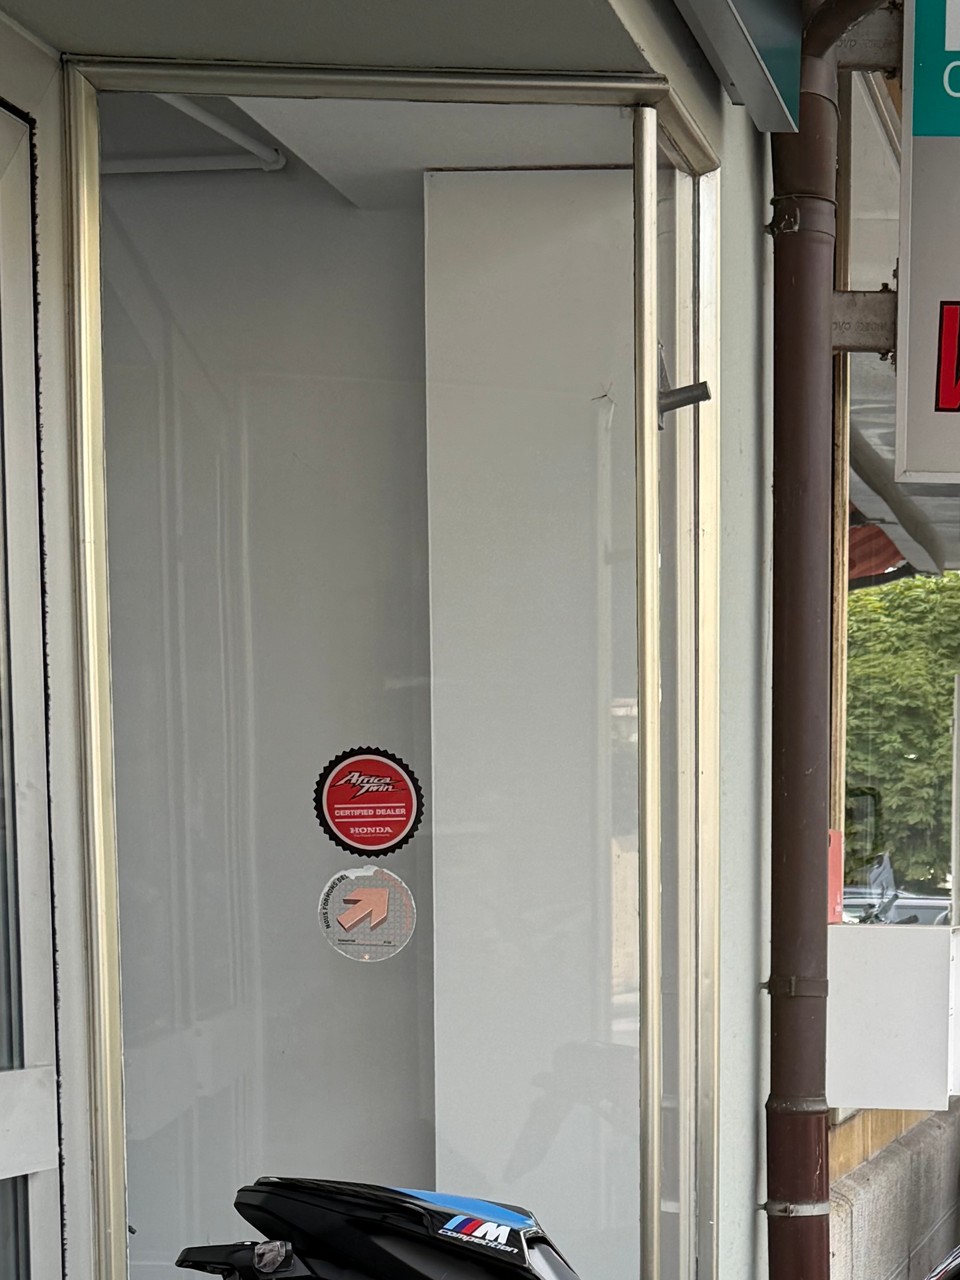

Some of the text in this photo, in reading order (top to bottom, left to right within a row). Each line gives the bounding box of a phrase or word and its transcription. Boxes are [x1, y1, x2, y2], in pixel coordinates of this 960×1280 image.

[332, 771, 402, 788] Africa
[350, 783, 405, 800] Twin
[438, 1228, 519, 1254] competition
